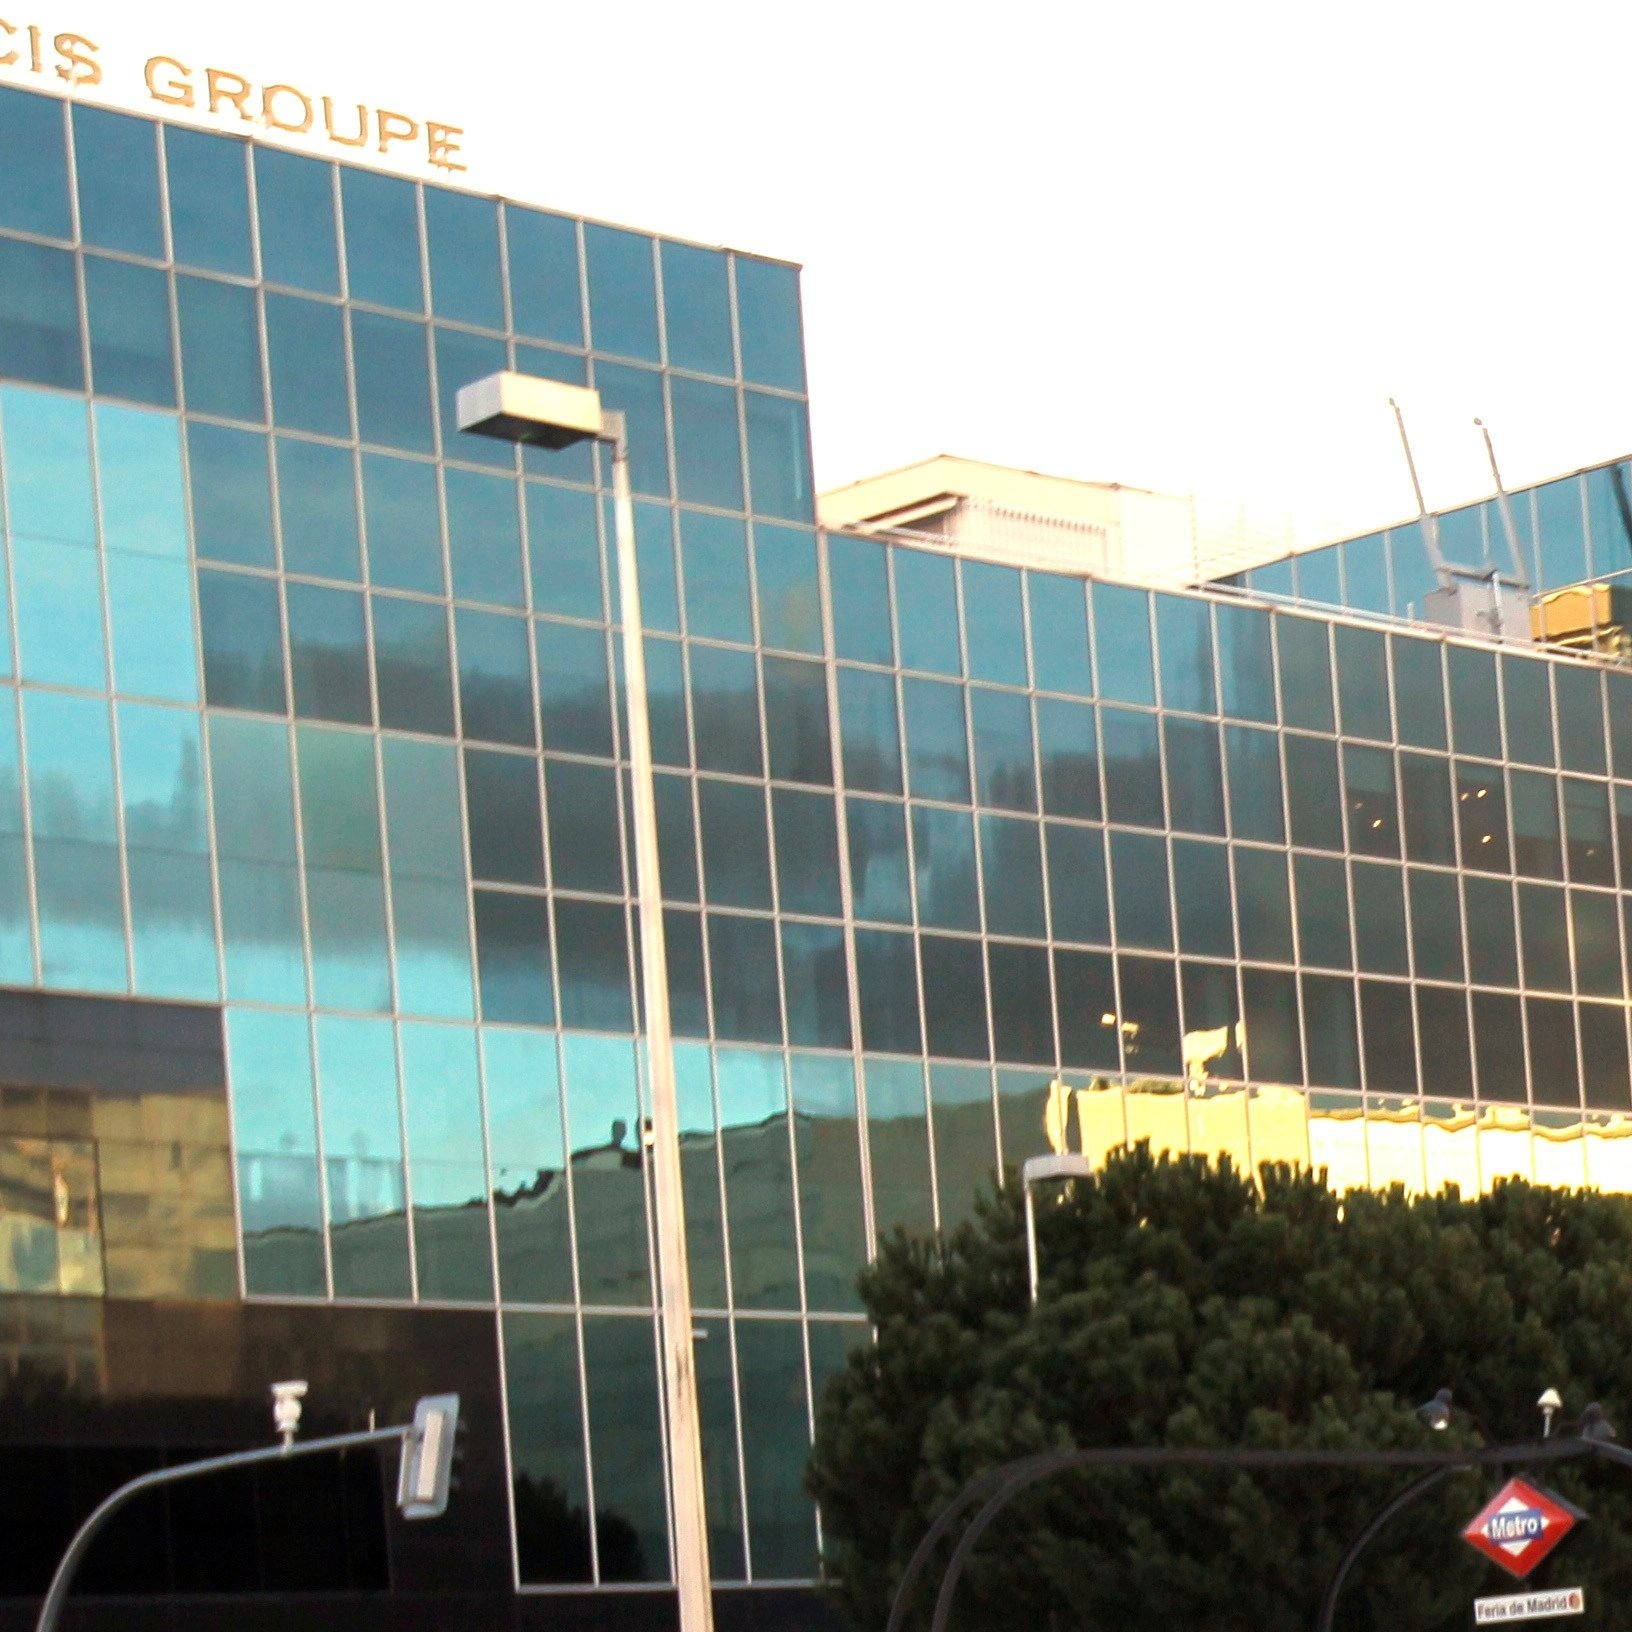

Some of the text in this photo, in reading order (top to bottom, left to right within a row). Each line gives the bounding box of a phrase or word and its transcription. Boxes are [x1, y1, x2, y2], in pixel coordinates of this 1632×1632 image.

[144, 56, 467, 171] GROUPE
[1490, 1514, 1538, 1538] Metro
[1477, 1595, 1567, 1618] Feria de Madrid
